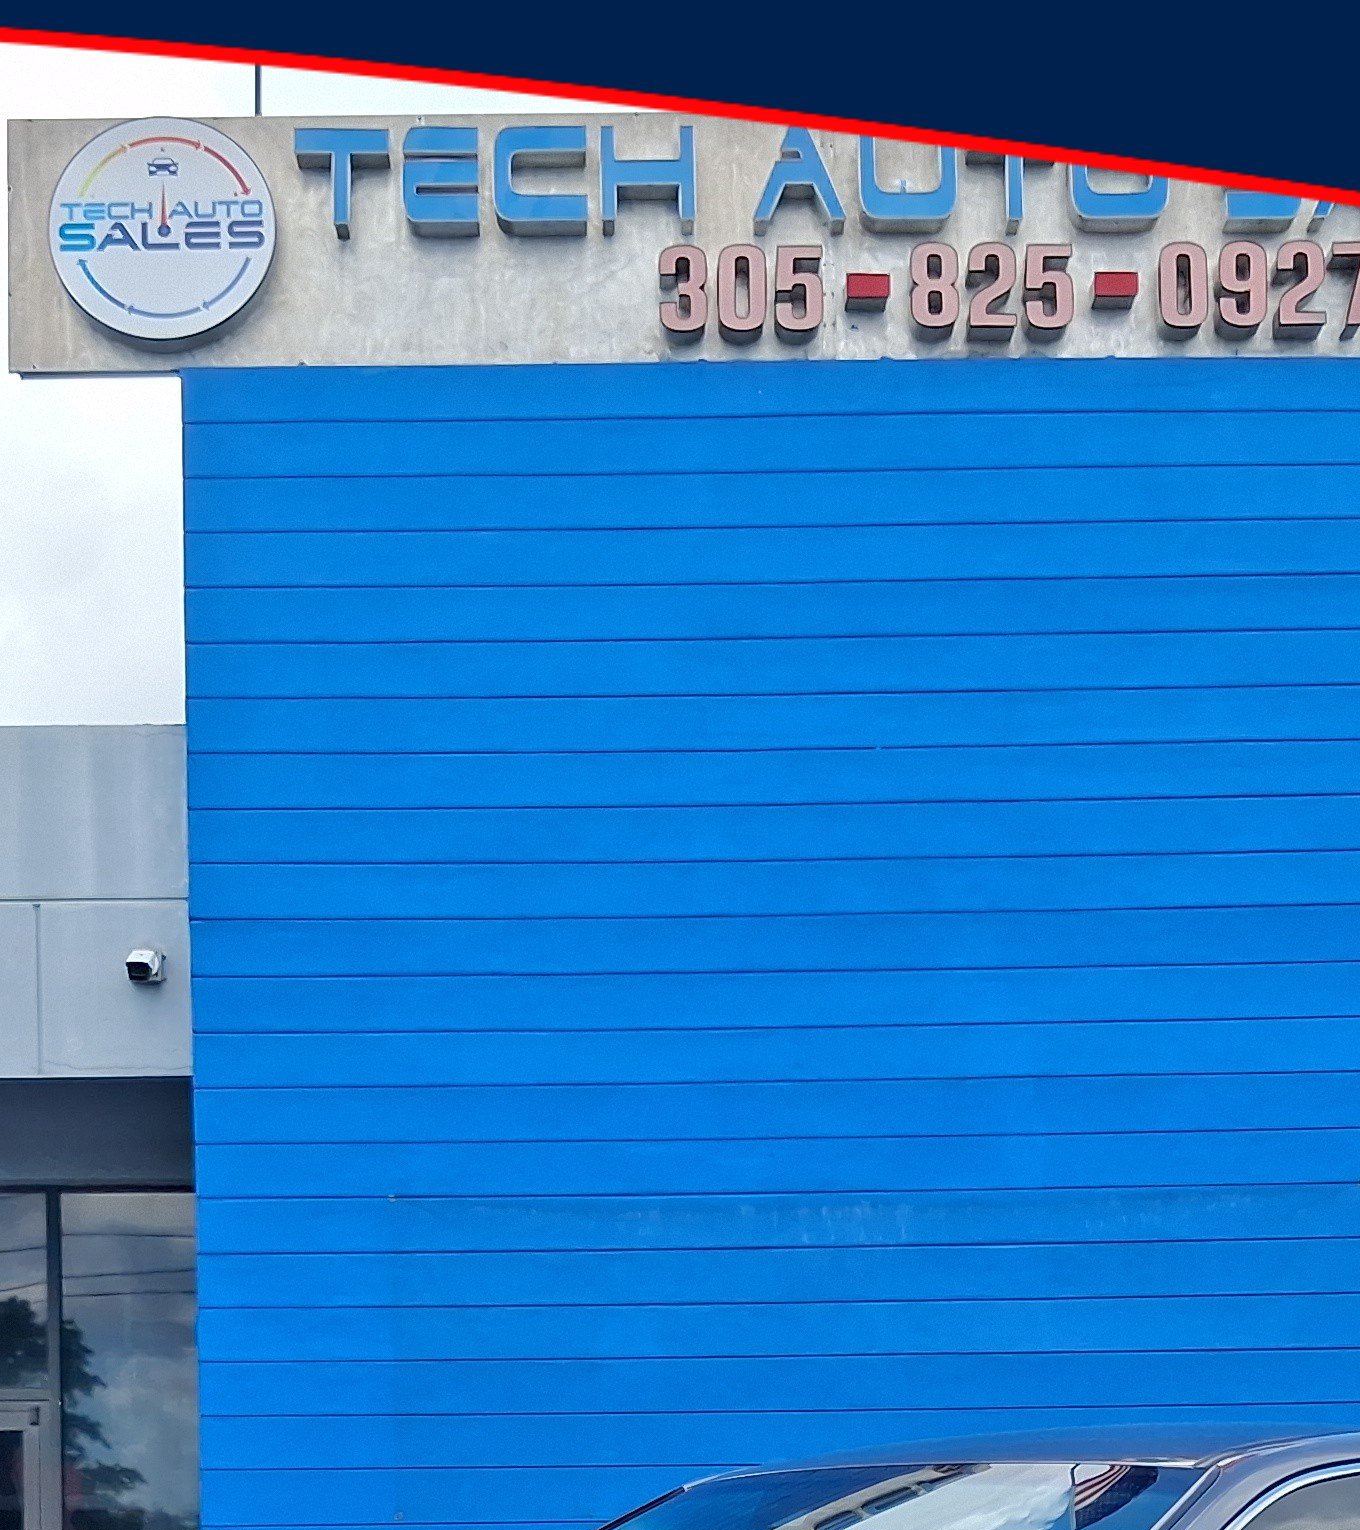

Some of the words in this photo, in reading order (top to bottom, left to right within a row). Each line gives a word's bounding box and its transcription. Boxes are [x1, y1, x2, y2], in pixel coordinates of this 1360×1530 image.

[293, 125, 696, 232] TECH
[60, 202, 153, 220] TECH
[168, 199, 264, 218] AUTO
[58, 220, 266, 252] SALES
